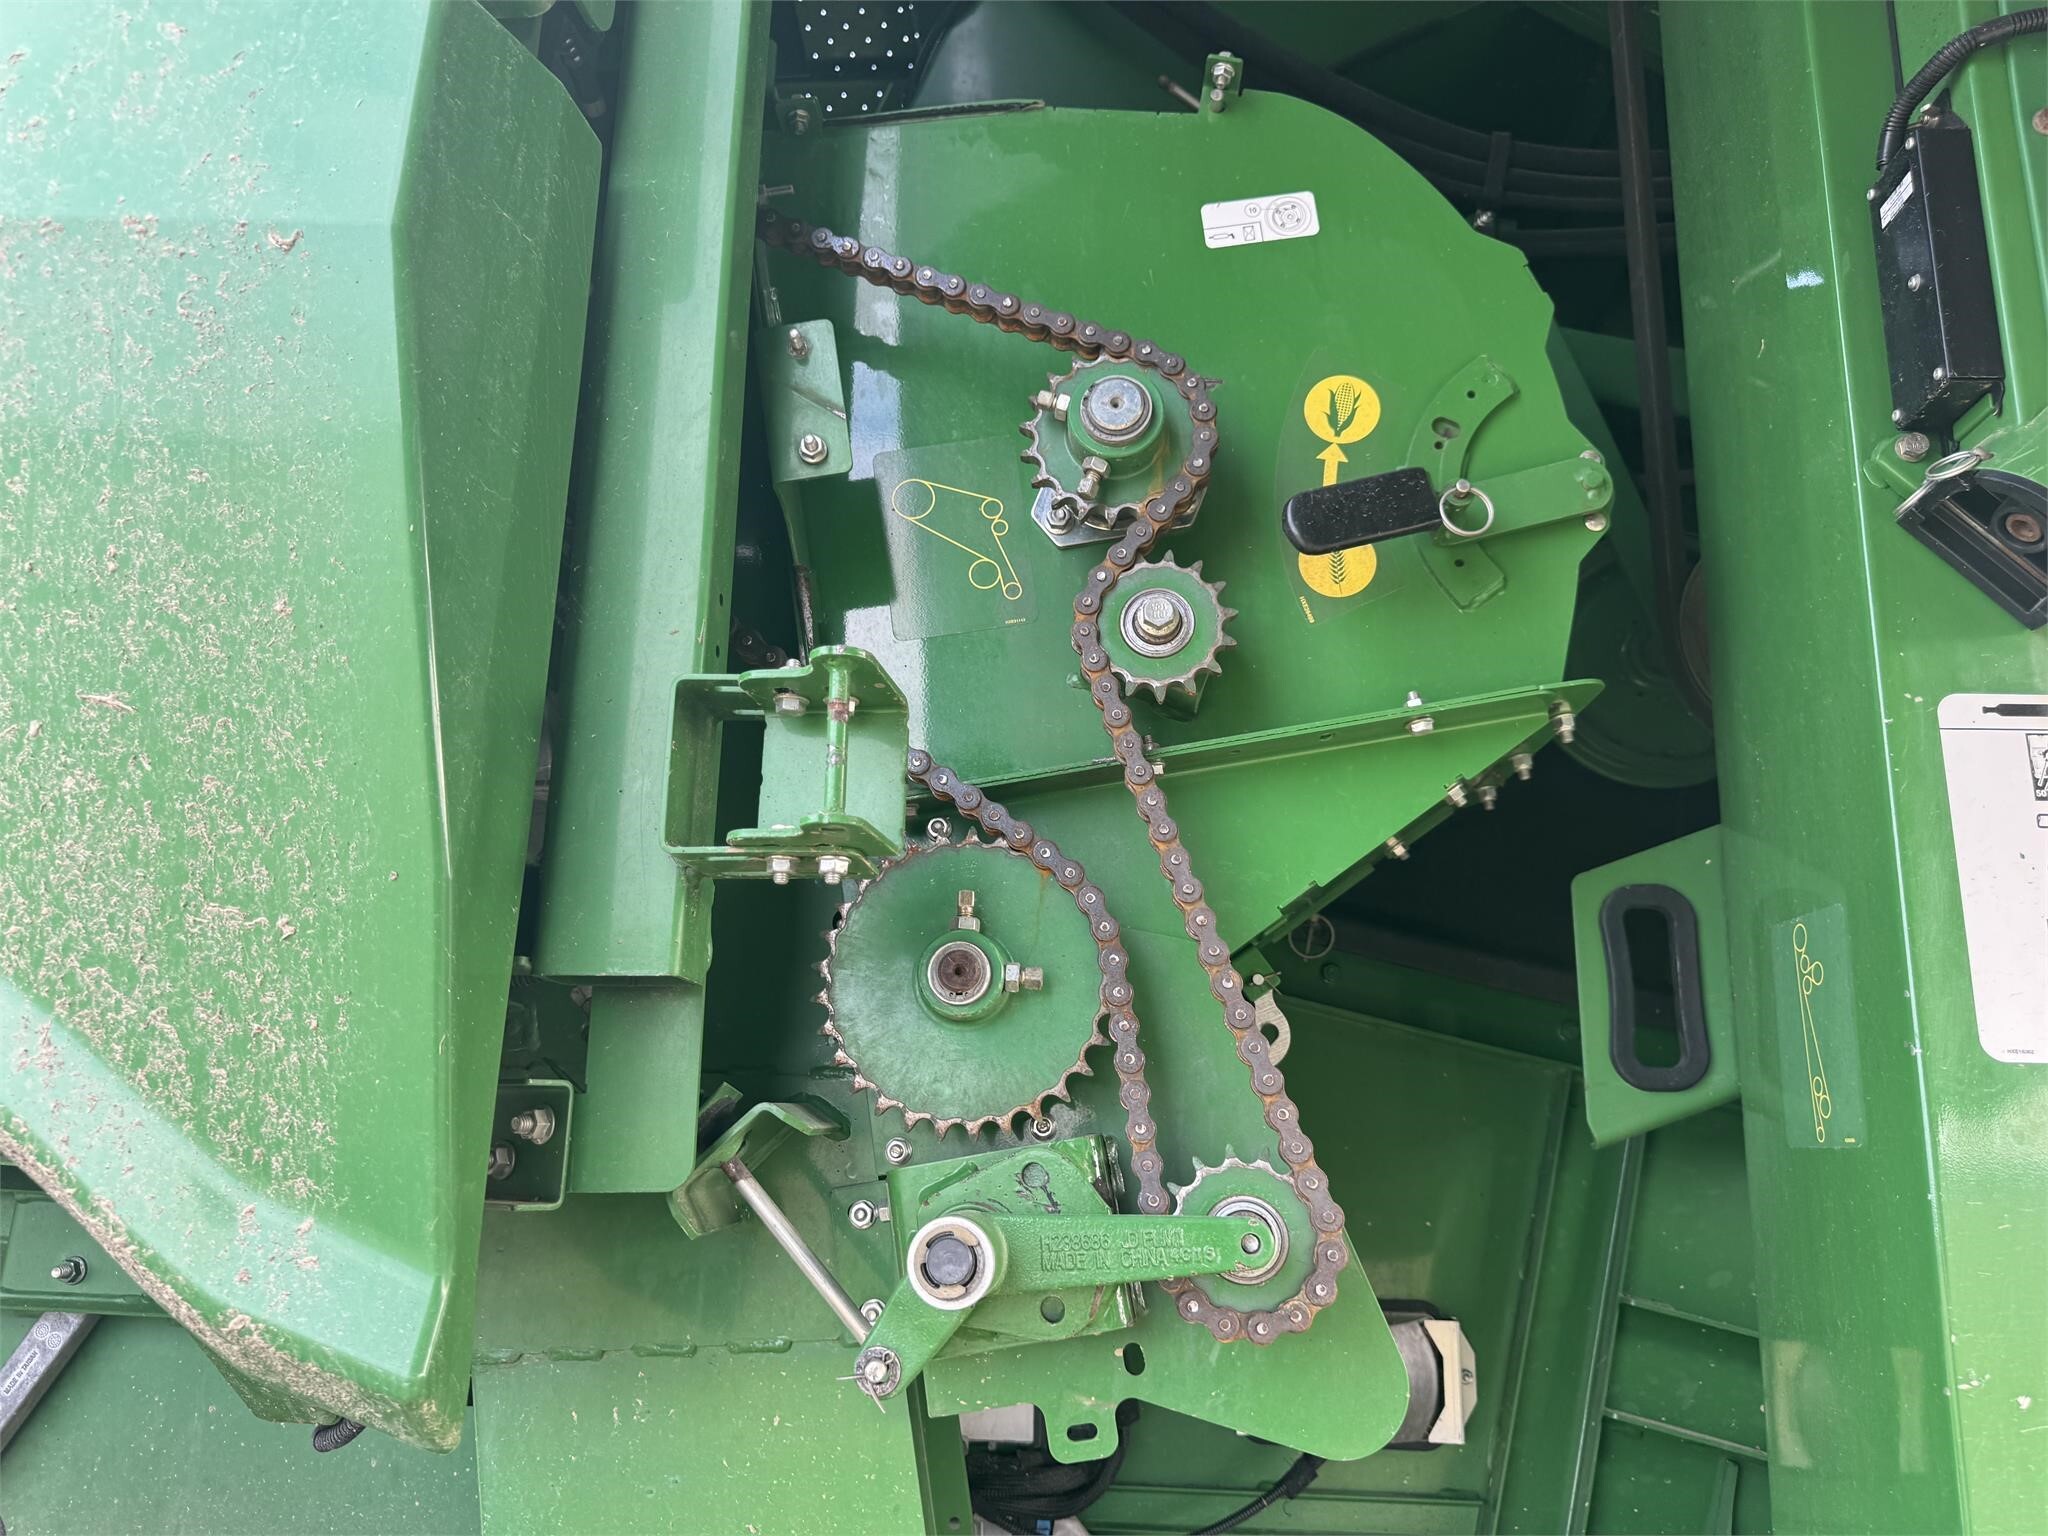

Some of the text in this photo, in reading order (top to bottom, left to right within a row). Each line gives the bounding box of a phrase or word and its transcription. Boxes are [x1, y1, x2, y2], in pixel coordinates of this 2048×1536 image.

[1041, 1250, 1087, 1272] MADE
[1121, 1245, 1170, 1270] CHINA
[3, 1377, 18, 1394] MADE
